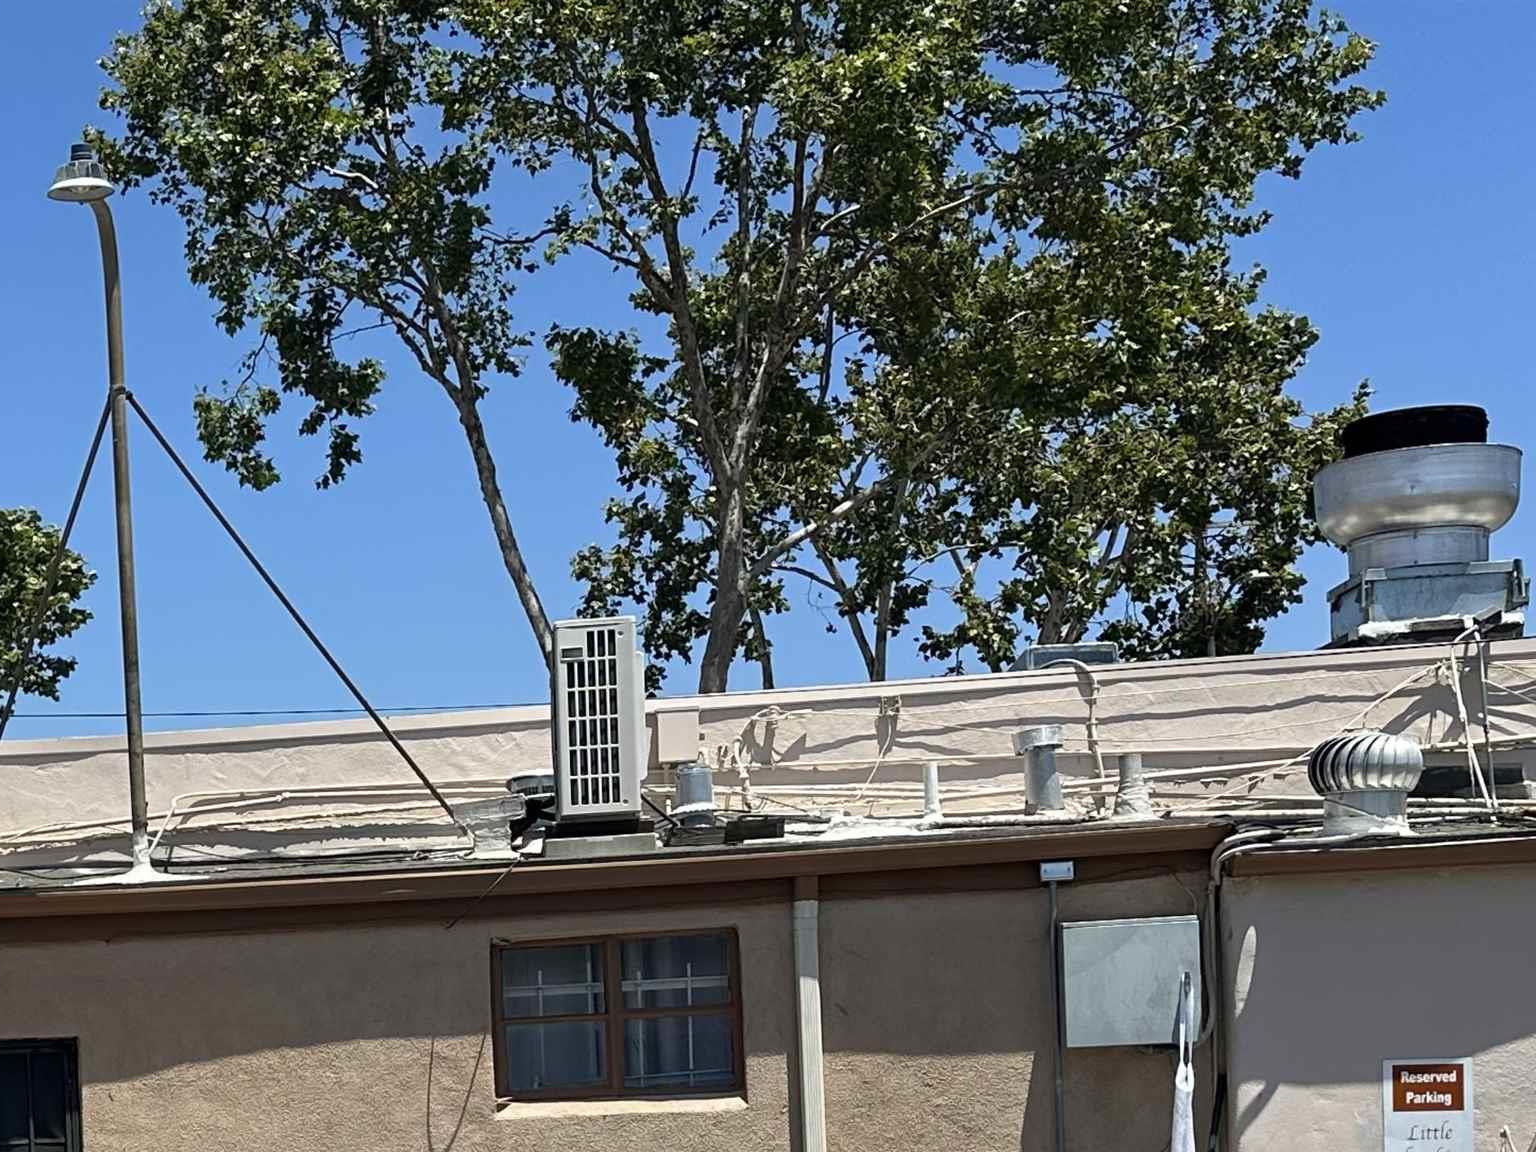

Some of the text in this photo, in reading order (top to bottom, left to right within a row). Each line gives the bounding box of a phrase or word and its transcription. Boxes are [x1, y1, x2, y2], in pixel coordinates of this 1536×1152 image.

[1400, 1071, 1457, 1084] Reserved
[1406, 1091, 1452, 1106] Parking
[1407, 1119, 1454, 1141] Little
